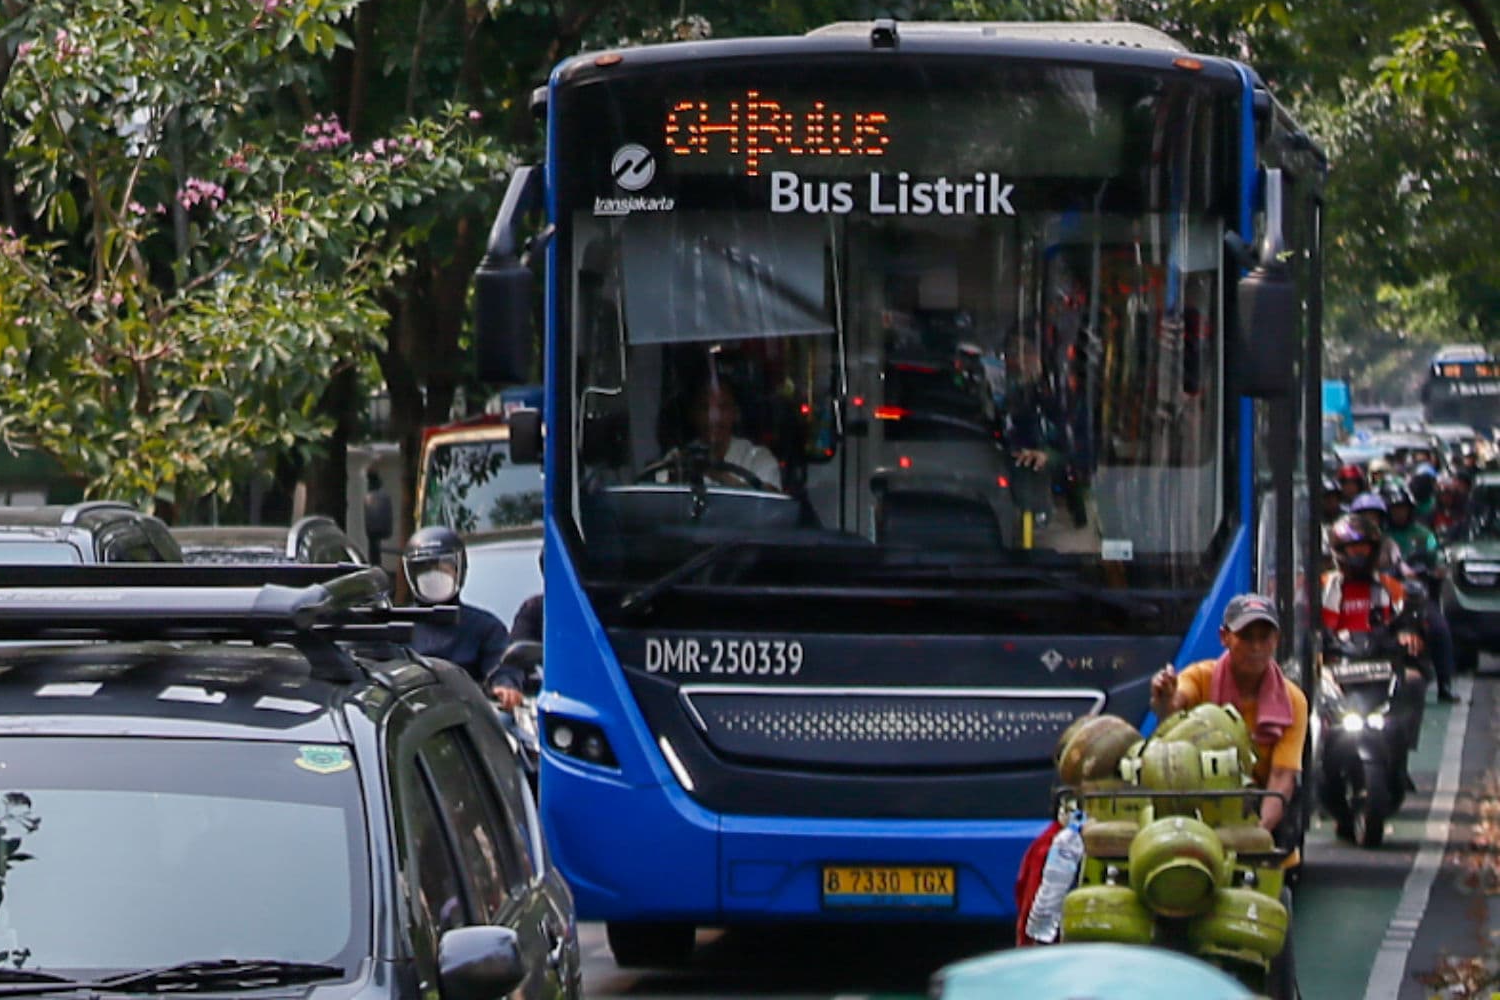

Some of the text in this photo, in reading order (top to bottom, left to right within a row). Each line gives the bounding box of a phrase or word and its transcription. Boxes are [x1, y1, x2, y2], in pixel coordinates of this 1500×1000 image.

[593, 196, 675, 213] transjakarta
[770, 171, 1016, 215] Bus Listrik
[645, 638, 804, 676] DMR-250339
[827, 870, 949, 893] B 7330 TGX
